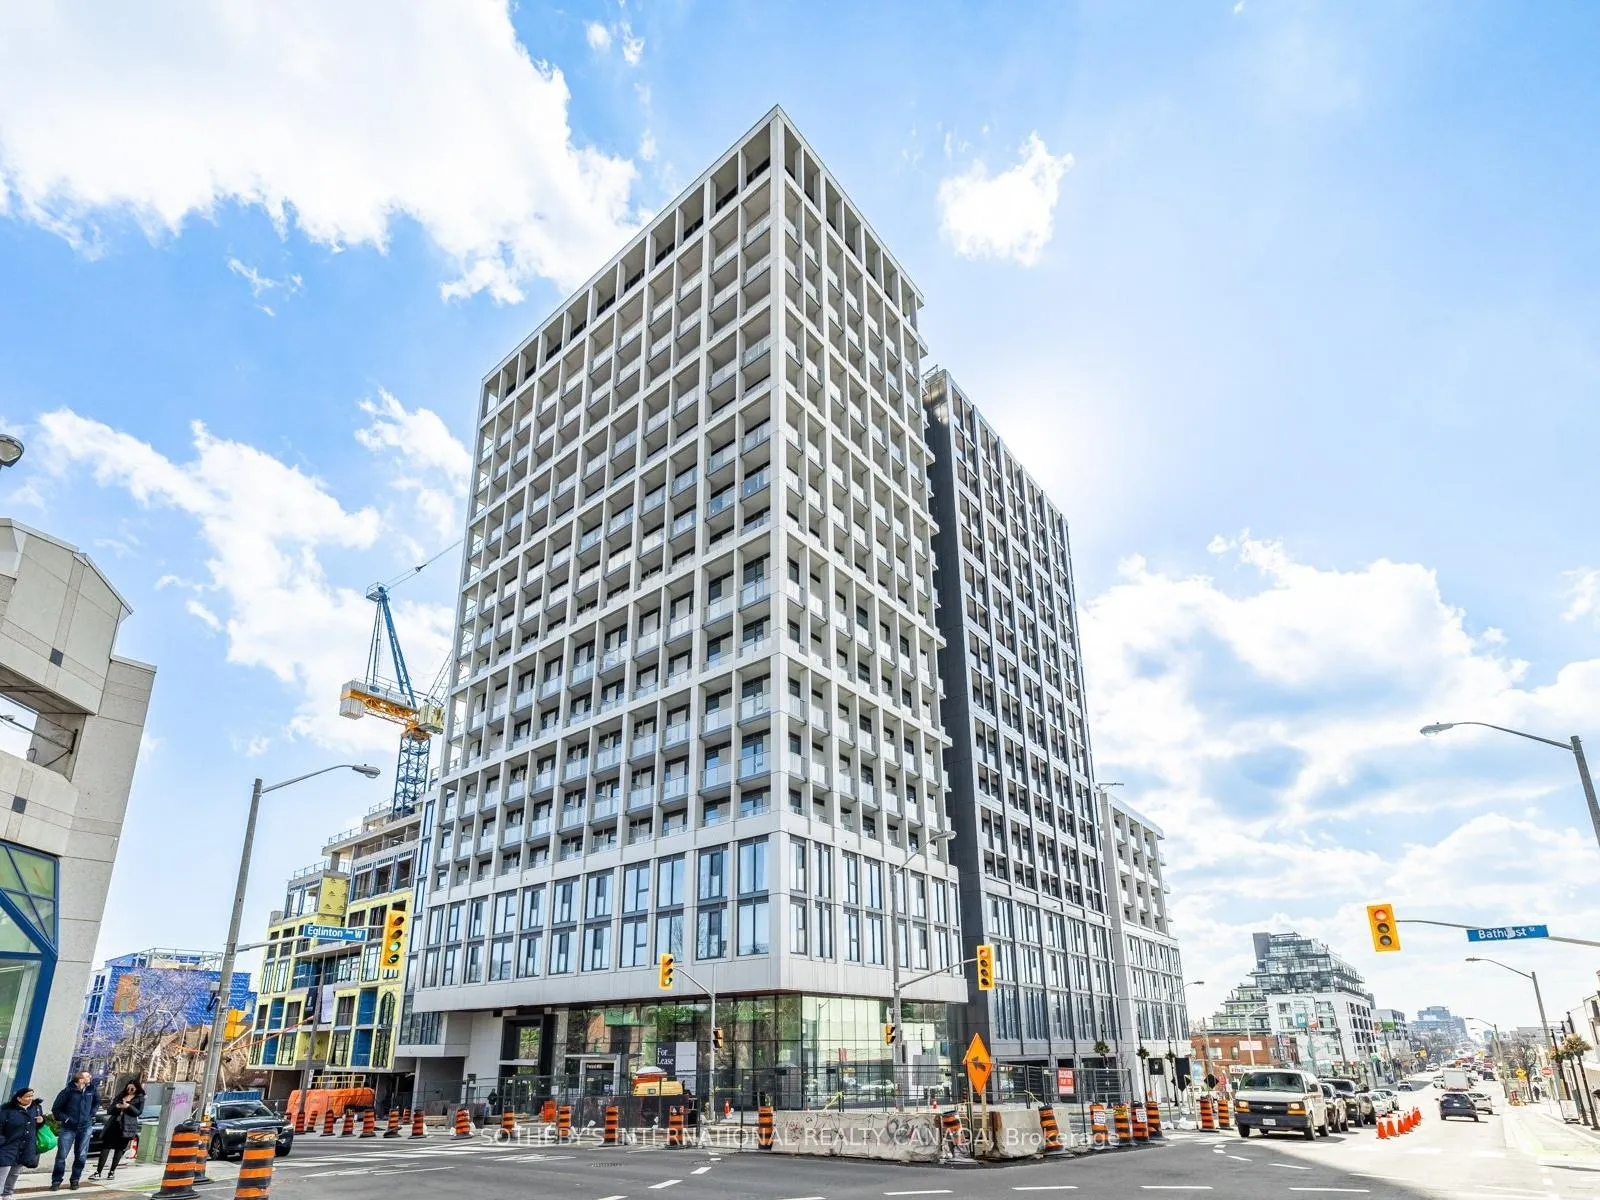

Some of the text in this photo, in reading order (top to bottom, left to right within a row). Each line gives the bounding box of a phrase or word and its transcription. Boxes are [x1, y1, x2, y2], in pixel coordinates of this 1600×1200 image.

[307, 926, 343, 937] Eglinton
[354, 930, 362, 938] W
[1478, 927, 1527, 939] Bathust
[657, 1047, 668, 1056] For
